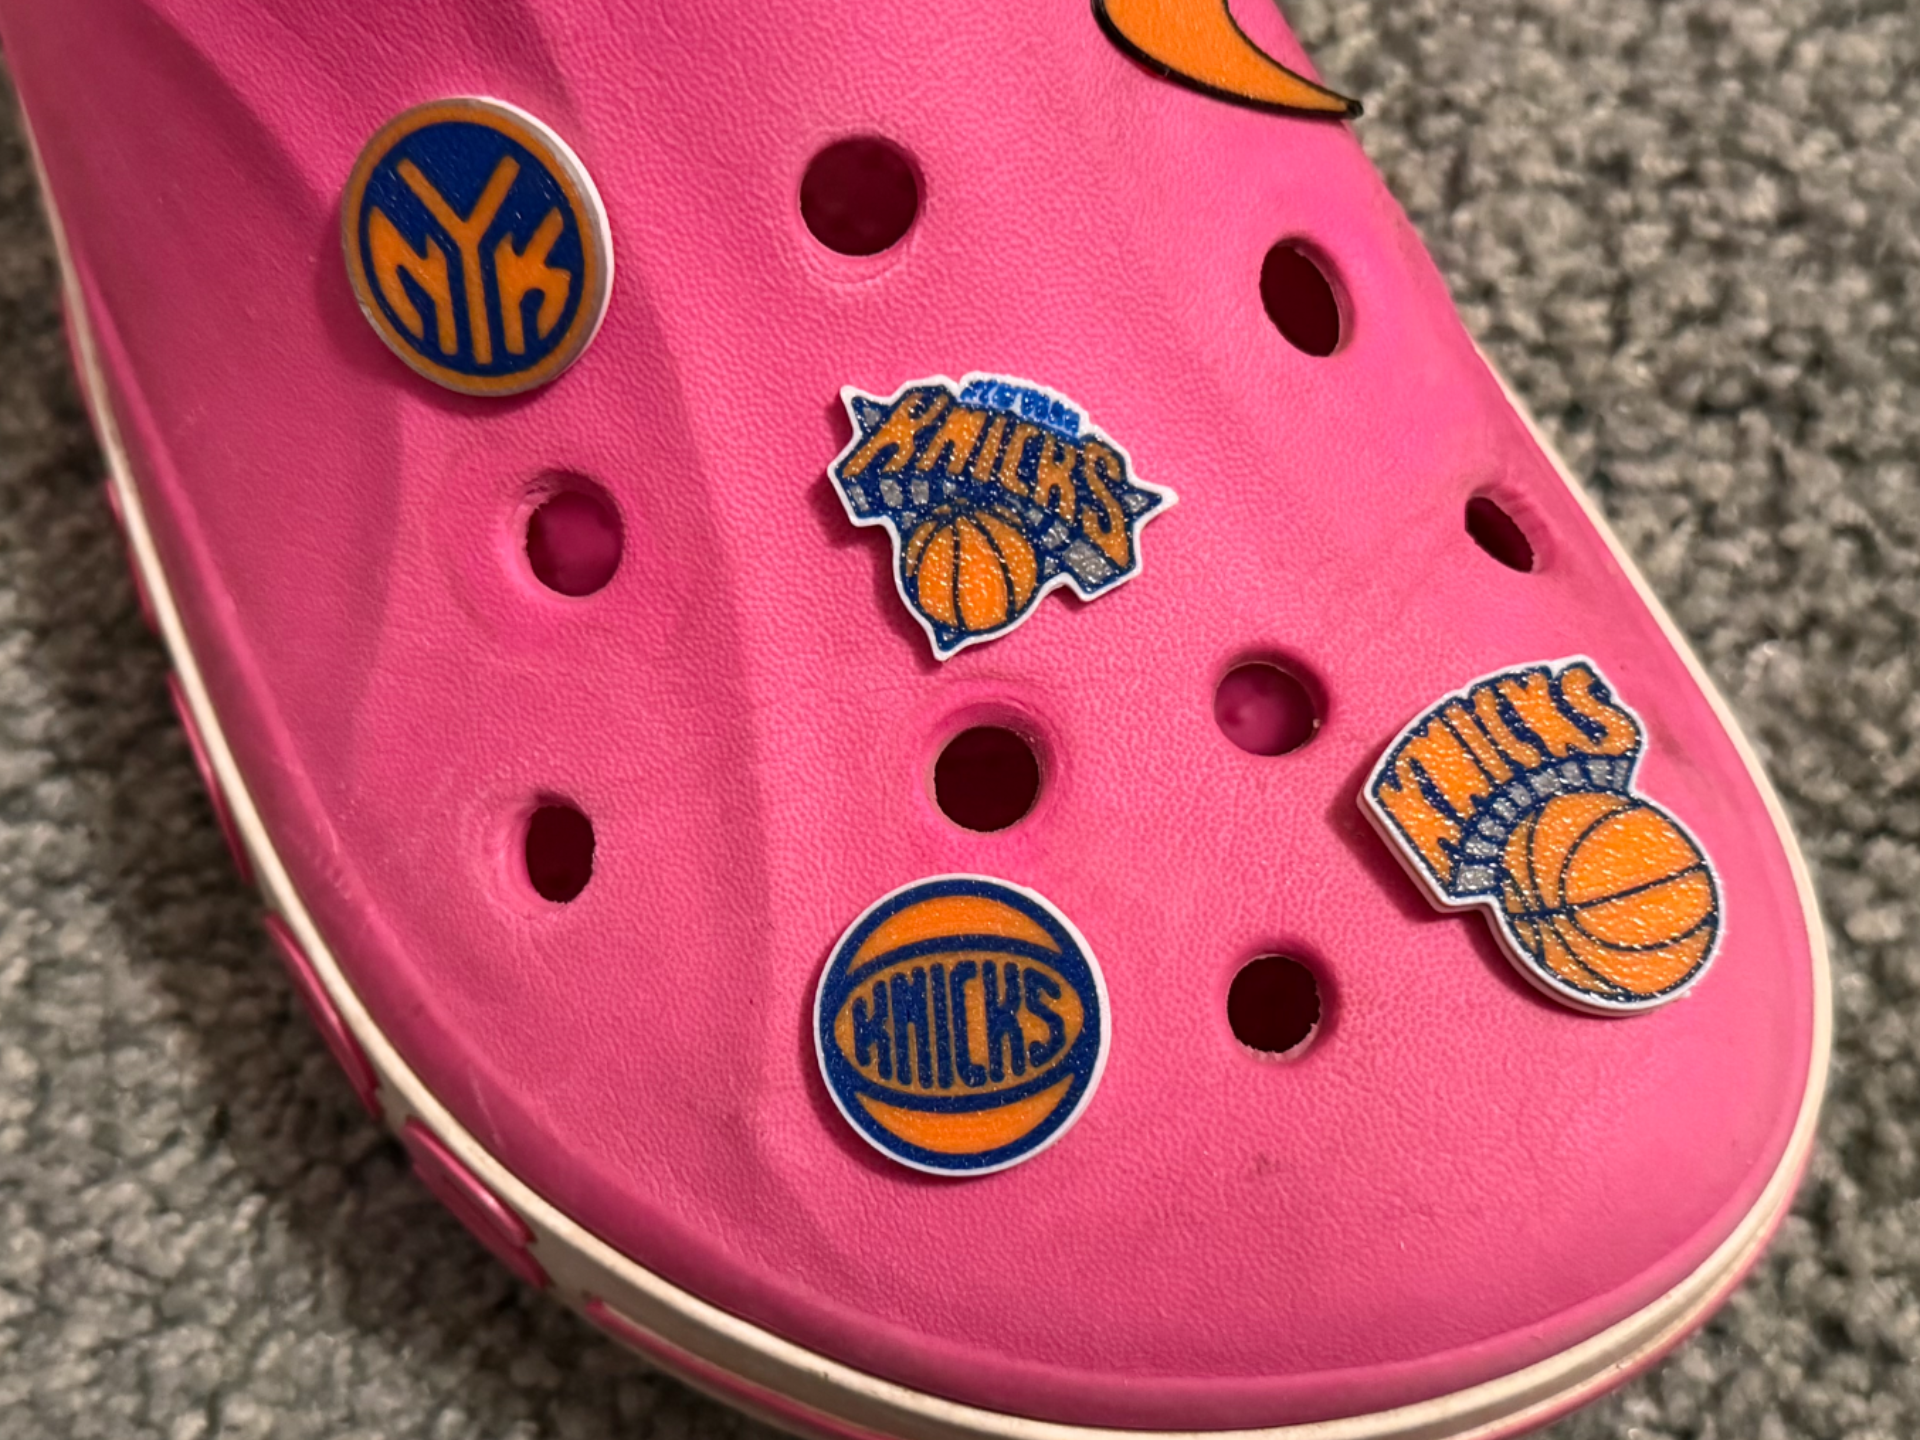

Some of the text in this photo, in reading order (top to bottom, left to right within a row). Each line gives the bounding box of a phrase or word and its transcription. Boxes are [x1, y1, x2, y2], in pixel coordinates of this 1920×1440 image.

[369, 156, 571, 365] NYK
[842, 393, 1130, 568] KNICKS
[852, 959, 1066, 1090] KNICKS
